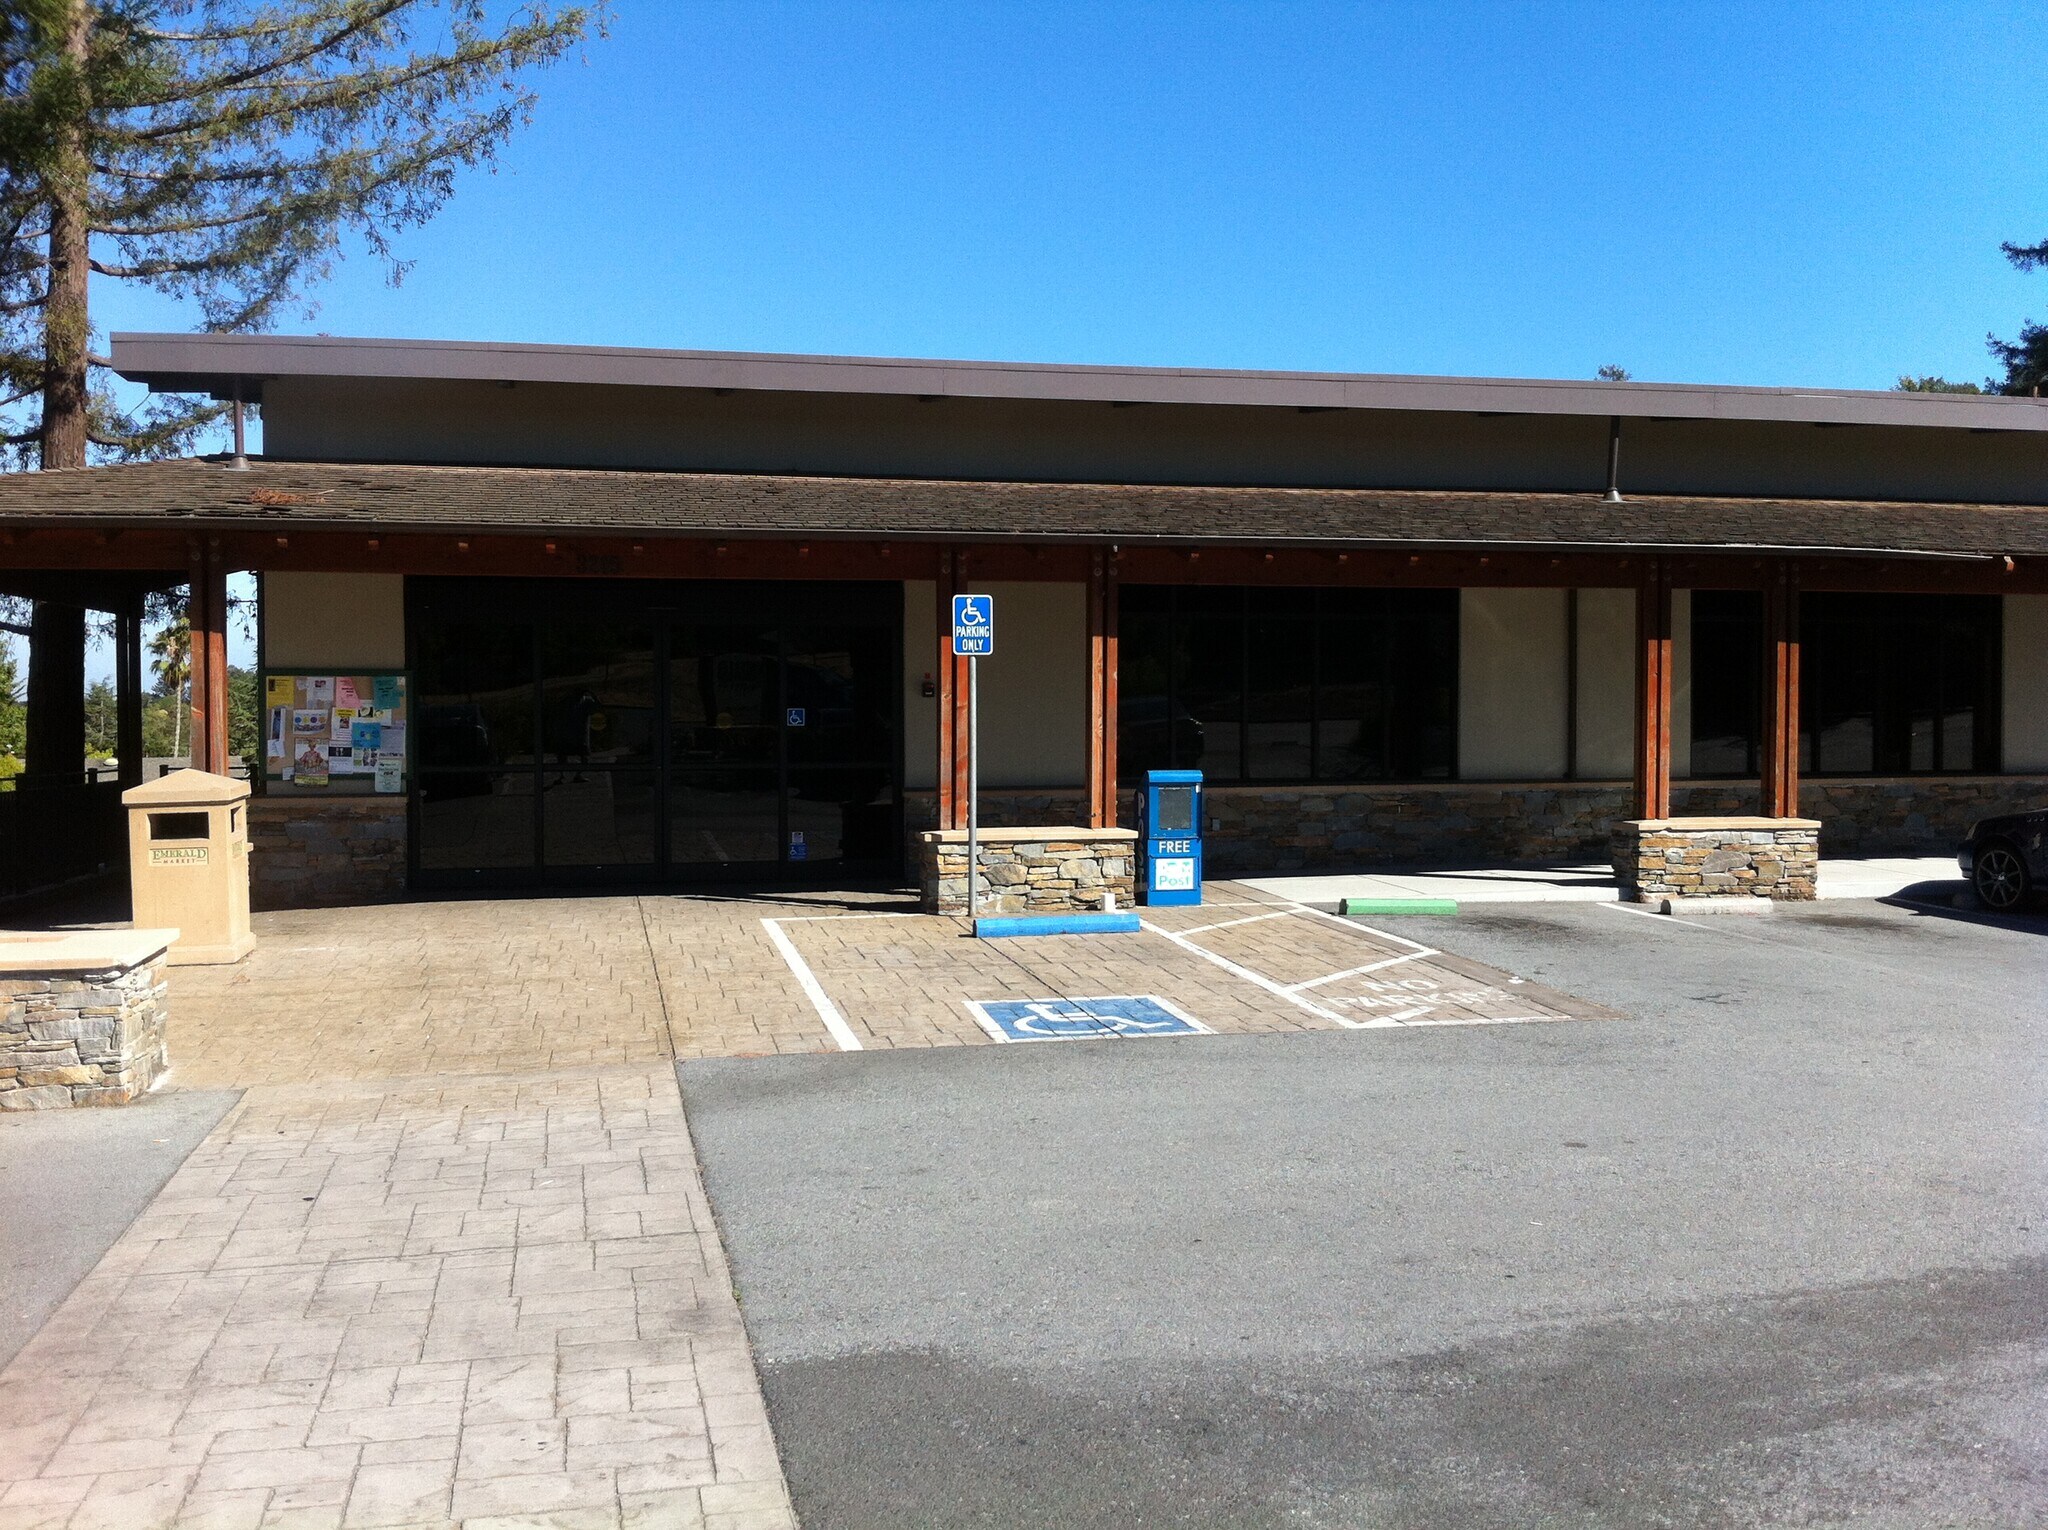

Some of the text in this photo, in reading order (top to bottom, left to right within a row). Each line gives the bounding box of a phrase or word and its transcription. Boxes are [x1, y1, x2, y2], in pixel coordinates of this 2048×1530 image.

[956, 626, 989, 637] PARKING
[962, 639, 984, 651] ONLY
[1137, 791, 1145, 890] POST
[1159, 841, 1190, 853] FREE
[153, 849, 206, 860] EMERALD
[1159, 875, 1190, 887] Post
[1360, 979, 1439, 992] NO
